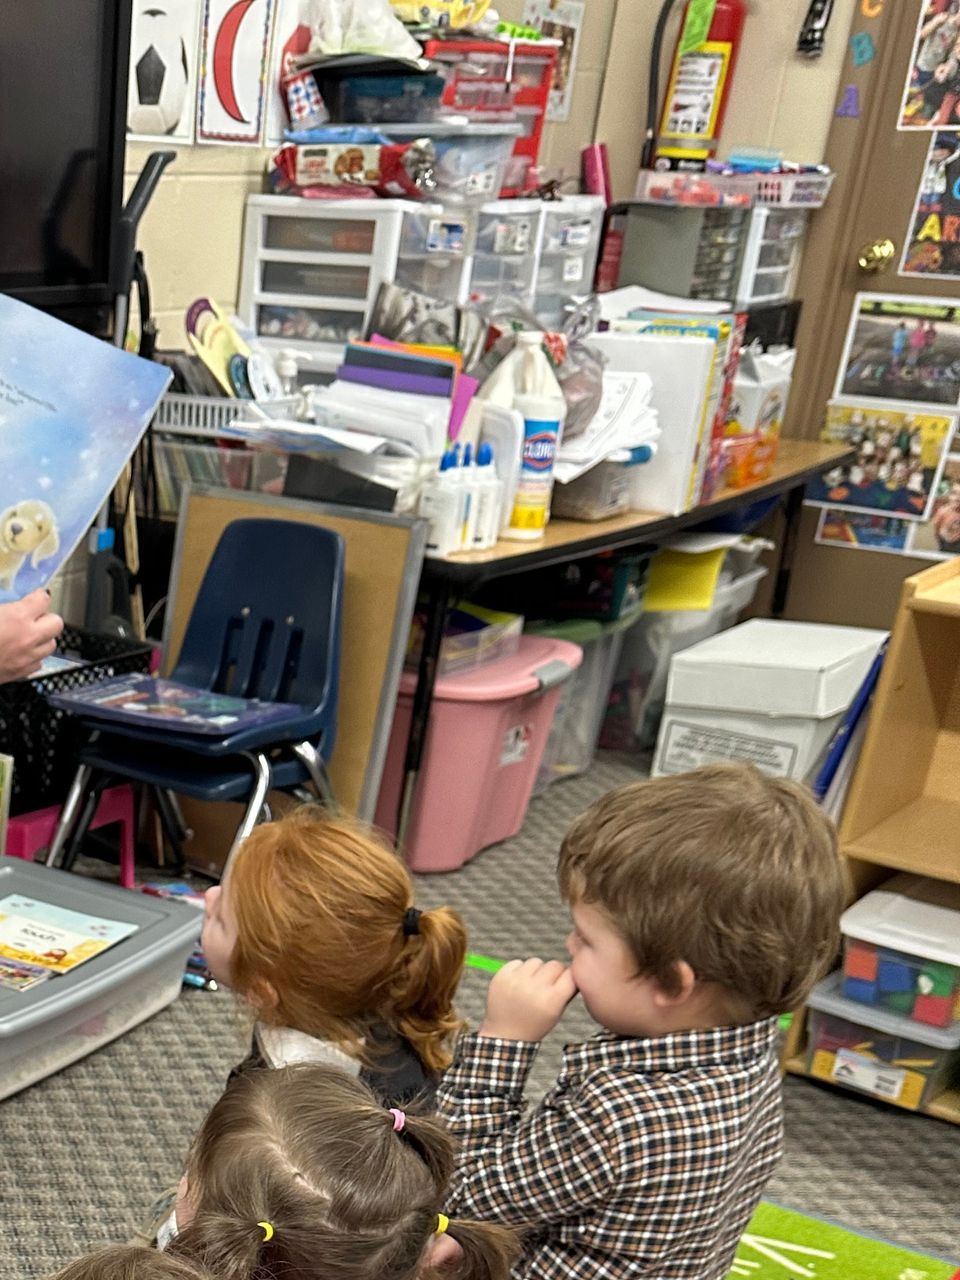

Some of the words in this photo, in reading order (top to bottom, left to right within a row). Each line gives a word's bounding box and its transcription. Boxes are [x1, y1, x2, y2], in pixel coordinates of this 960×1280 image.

[850, 31, 876, 66] B
[836, 84, 861, 118] A
[916, 213, 960, 242] AR
